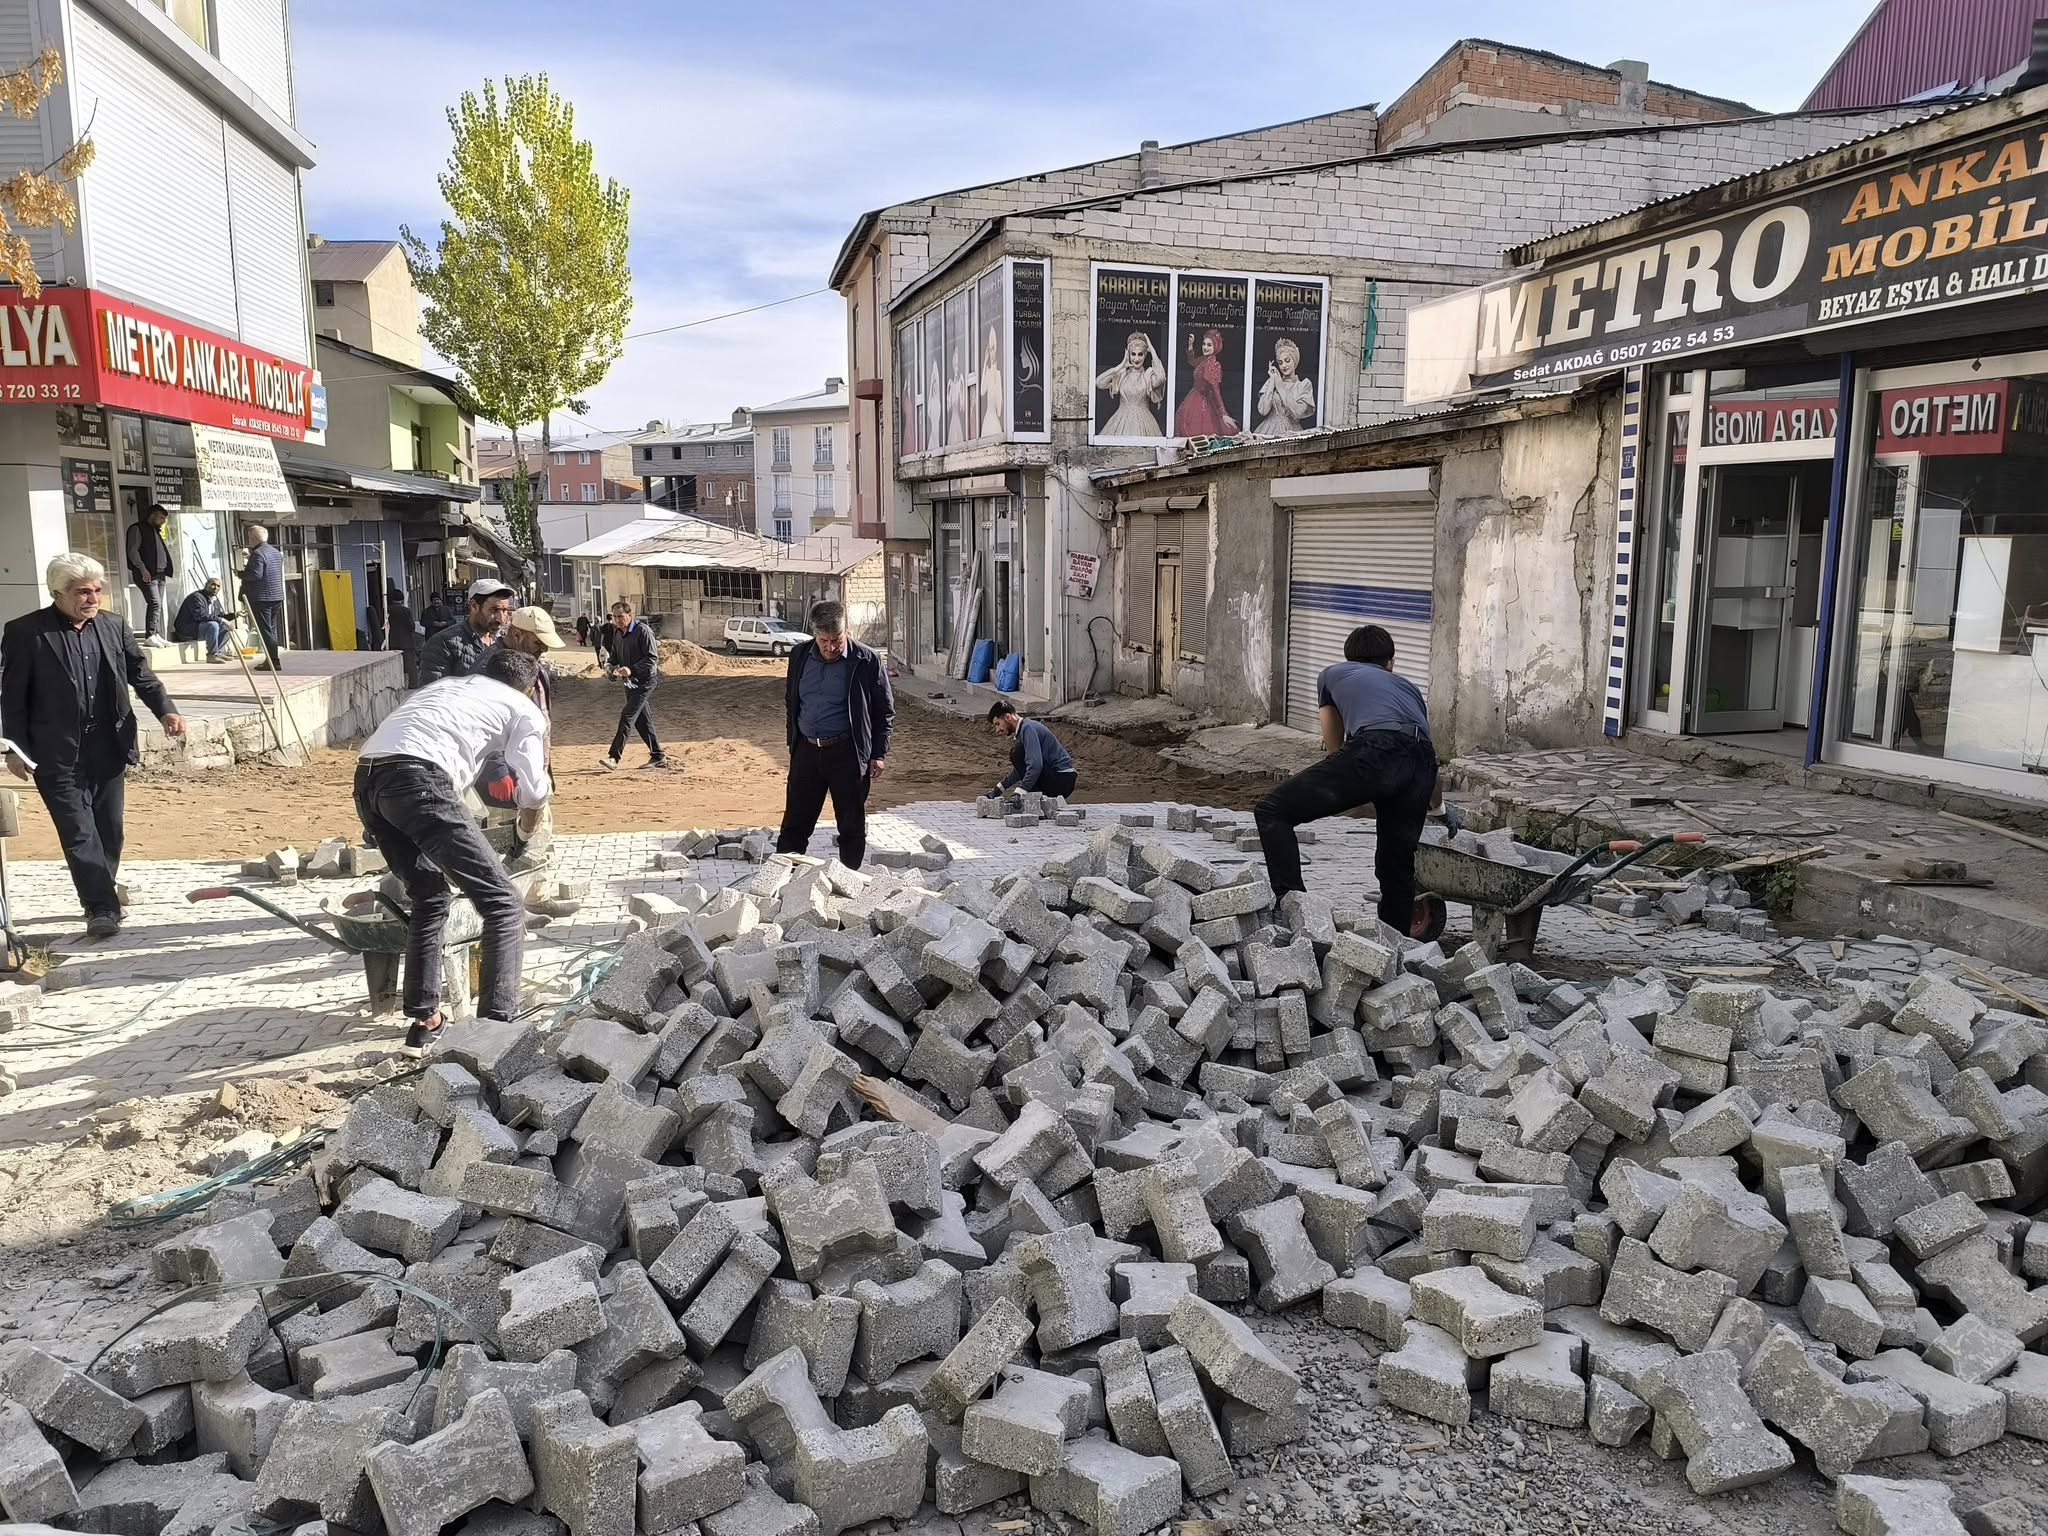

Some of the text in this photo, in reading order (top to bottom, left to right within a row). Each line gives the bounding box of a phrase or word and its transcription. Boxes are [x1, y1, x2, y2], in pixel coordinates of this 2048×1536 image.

[1841, 132, 2048, 224] ANKA
[1821, 196, 2048, 283] MOBİL
[1014, 267, 1043, 279] KARDELEN
[1016, 281, 1039, 295] Bayan
[1099, 275, 1168, 297] KARDELEN
[1179, 280, 1246, 301] KARDELEN
[1477, 205, 1811, 362] METRO
[1818, 287, 1882, 322] BEYAZ
[1885, 276, 1940, 312] EŞYA
[1945, 271, 1963, 296] &
[1968, 258, 2029, 292] HALI
[1256, 285, 1320, 305] KARDELEN
[1099, 297, 1128, 314] Bayan
[1179, 302, 1207, 320] Bayan
[1256, 306, 1283, 322] Bayan
[1014, 320, 1042, 329] TASARIM
[0, 305, 78, 366] LYA
[104, 309, 178, 385] METRO
[183, 335, 252, 403] ANKARA
[1513, 325, 1735, 381] Sedat AKDAĞ 0507 262 54 53
[7, 384, 36, 398] 720
[40, 384, 59, 398] 33
[63, 384, 80, 398] 12
[154, 467, 174, 476] TOPTAN
